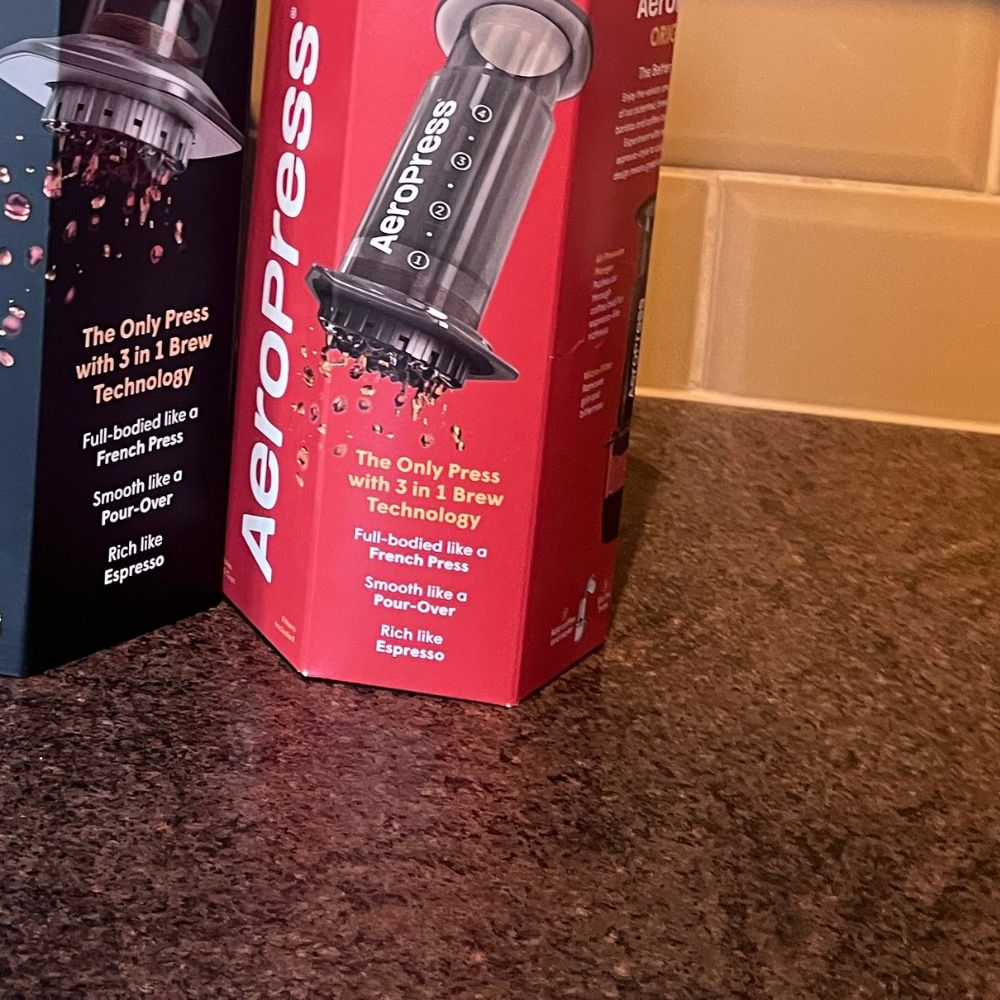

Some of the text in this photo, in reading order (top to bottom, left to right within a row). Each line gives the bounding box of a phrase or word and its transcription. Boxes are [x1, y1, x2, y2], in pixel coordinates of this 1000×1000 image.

[369, 99, 458, 255] AeroPress
[82, 306, 210, 348] The Only Press
[75, 333, 213, 380] with 3 in 1 Brew
[93, 366, 194, 405] Technology
[82, 406, 199, 449] Full-bodied like a
[96, 431, 184, 467] French Press
[355, 449, 501, 484] The Only Press
[92, 469, 183, 507] Smooth like a
[348, 473, 504, 506] with 3 in 1 Brew
[101, 492, 174, 527] Pour-Over
[366, 496, 481, 530] Technology
[108, 534, 163, 563] Rich like
[354, 527, 488, 558] Full-bodied like a
[369, 546, 470, 573] French Press
[104, 554, 165, 586] Espresso
[364, 575, 468, 603] Smooth like a
[373, 593, 457, 617] Pour-Over
[375, 639, 445, 661] Espresso
[380, 624, 444, 645] Rich like
